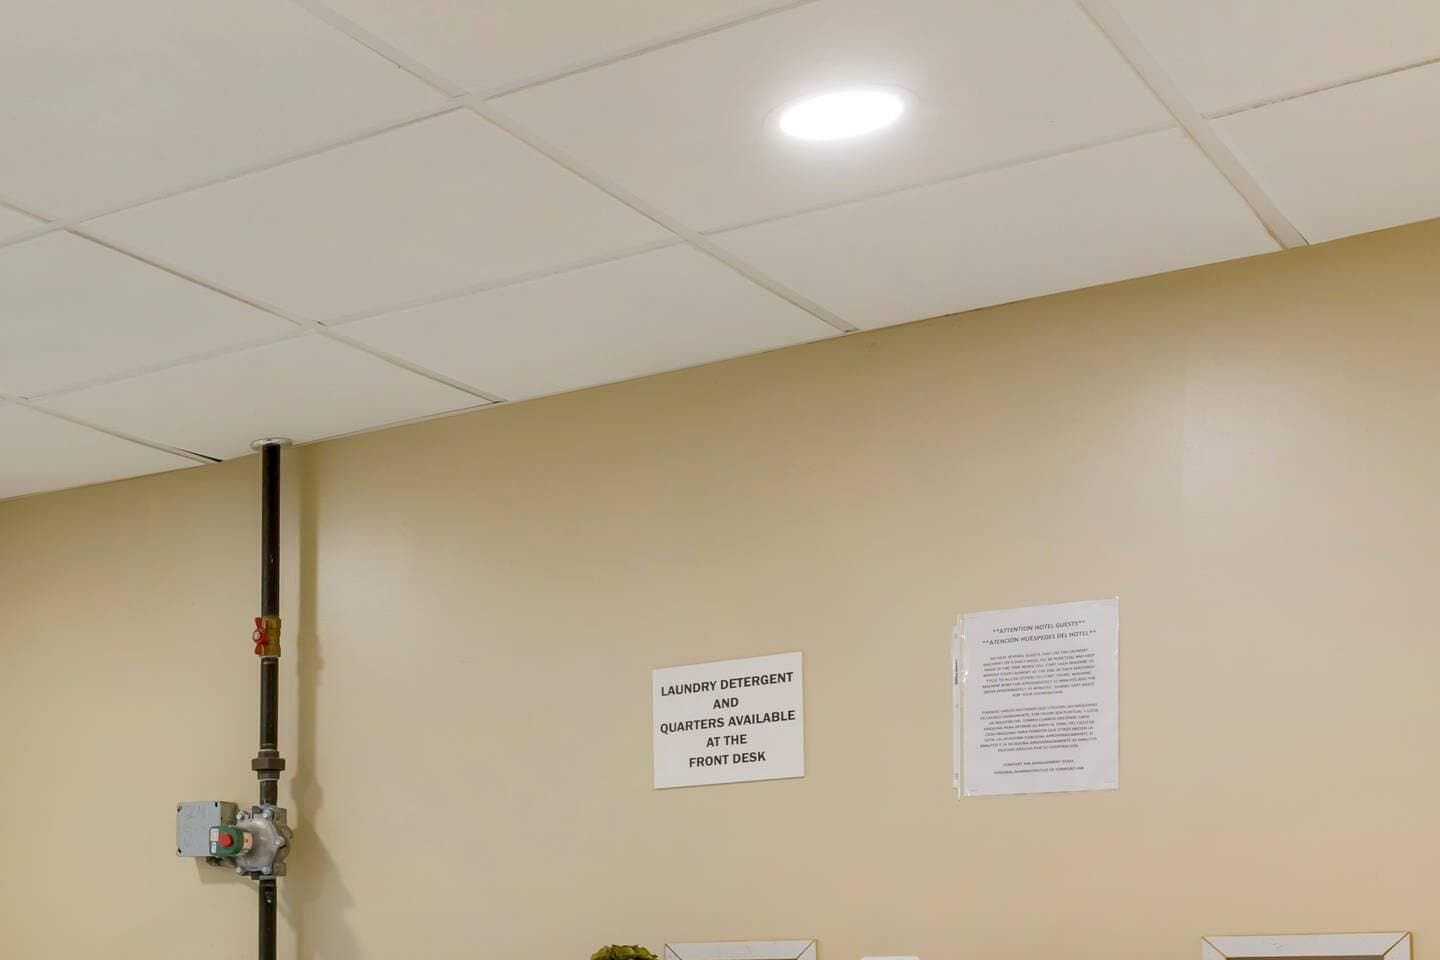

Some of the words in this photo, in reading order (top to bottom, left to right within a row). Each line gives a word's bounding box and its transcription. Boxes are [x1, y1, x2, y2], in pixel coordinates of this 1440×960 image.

[661, 680, 717, 697] LAUNDRY
[720, 671, 794, 690] DETERGENT
[713, 697, 739, 709] AND
[660, 717, 725, 735] QUARTERS
[728, 710, 796, 726] AVAILABLE
[706, 736, 720, 747] AT
[723, 734, 747, 745] THE
[689, 754, 729, 768] FRONT
[733, 751, 766, 764] DESK
